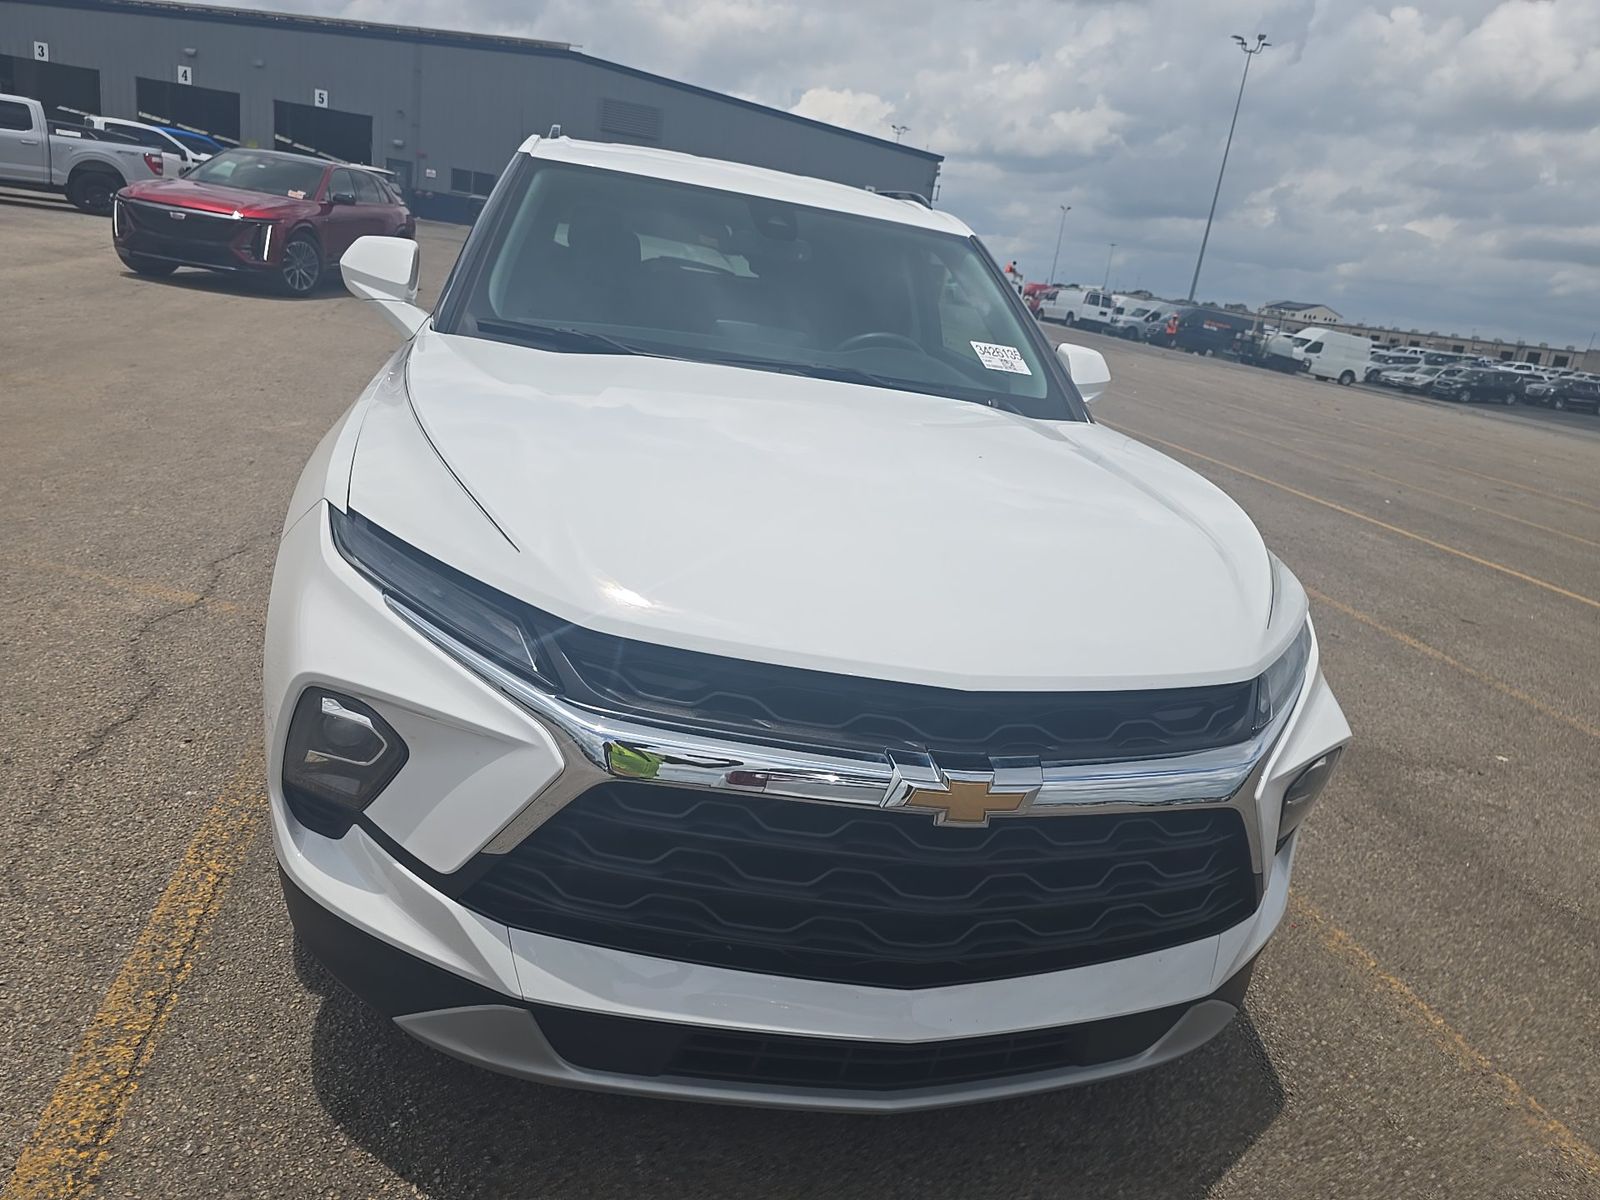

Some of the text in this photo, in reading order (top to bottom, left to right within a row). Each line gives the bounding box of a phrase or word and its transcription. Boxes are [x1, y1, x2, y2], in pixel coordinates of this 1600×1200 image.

[38, 45, 45, 57] 3
[181, 69, 188, 81] 4
[318, 92, 325, 104] 5
[975, 344, 1023, 360] 3426135
